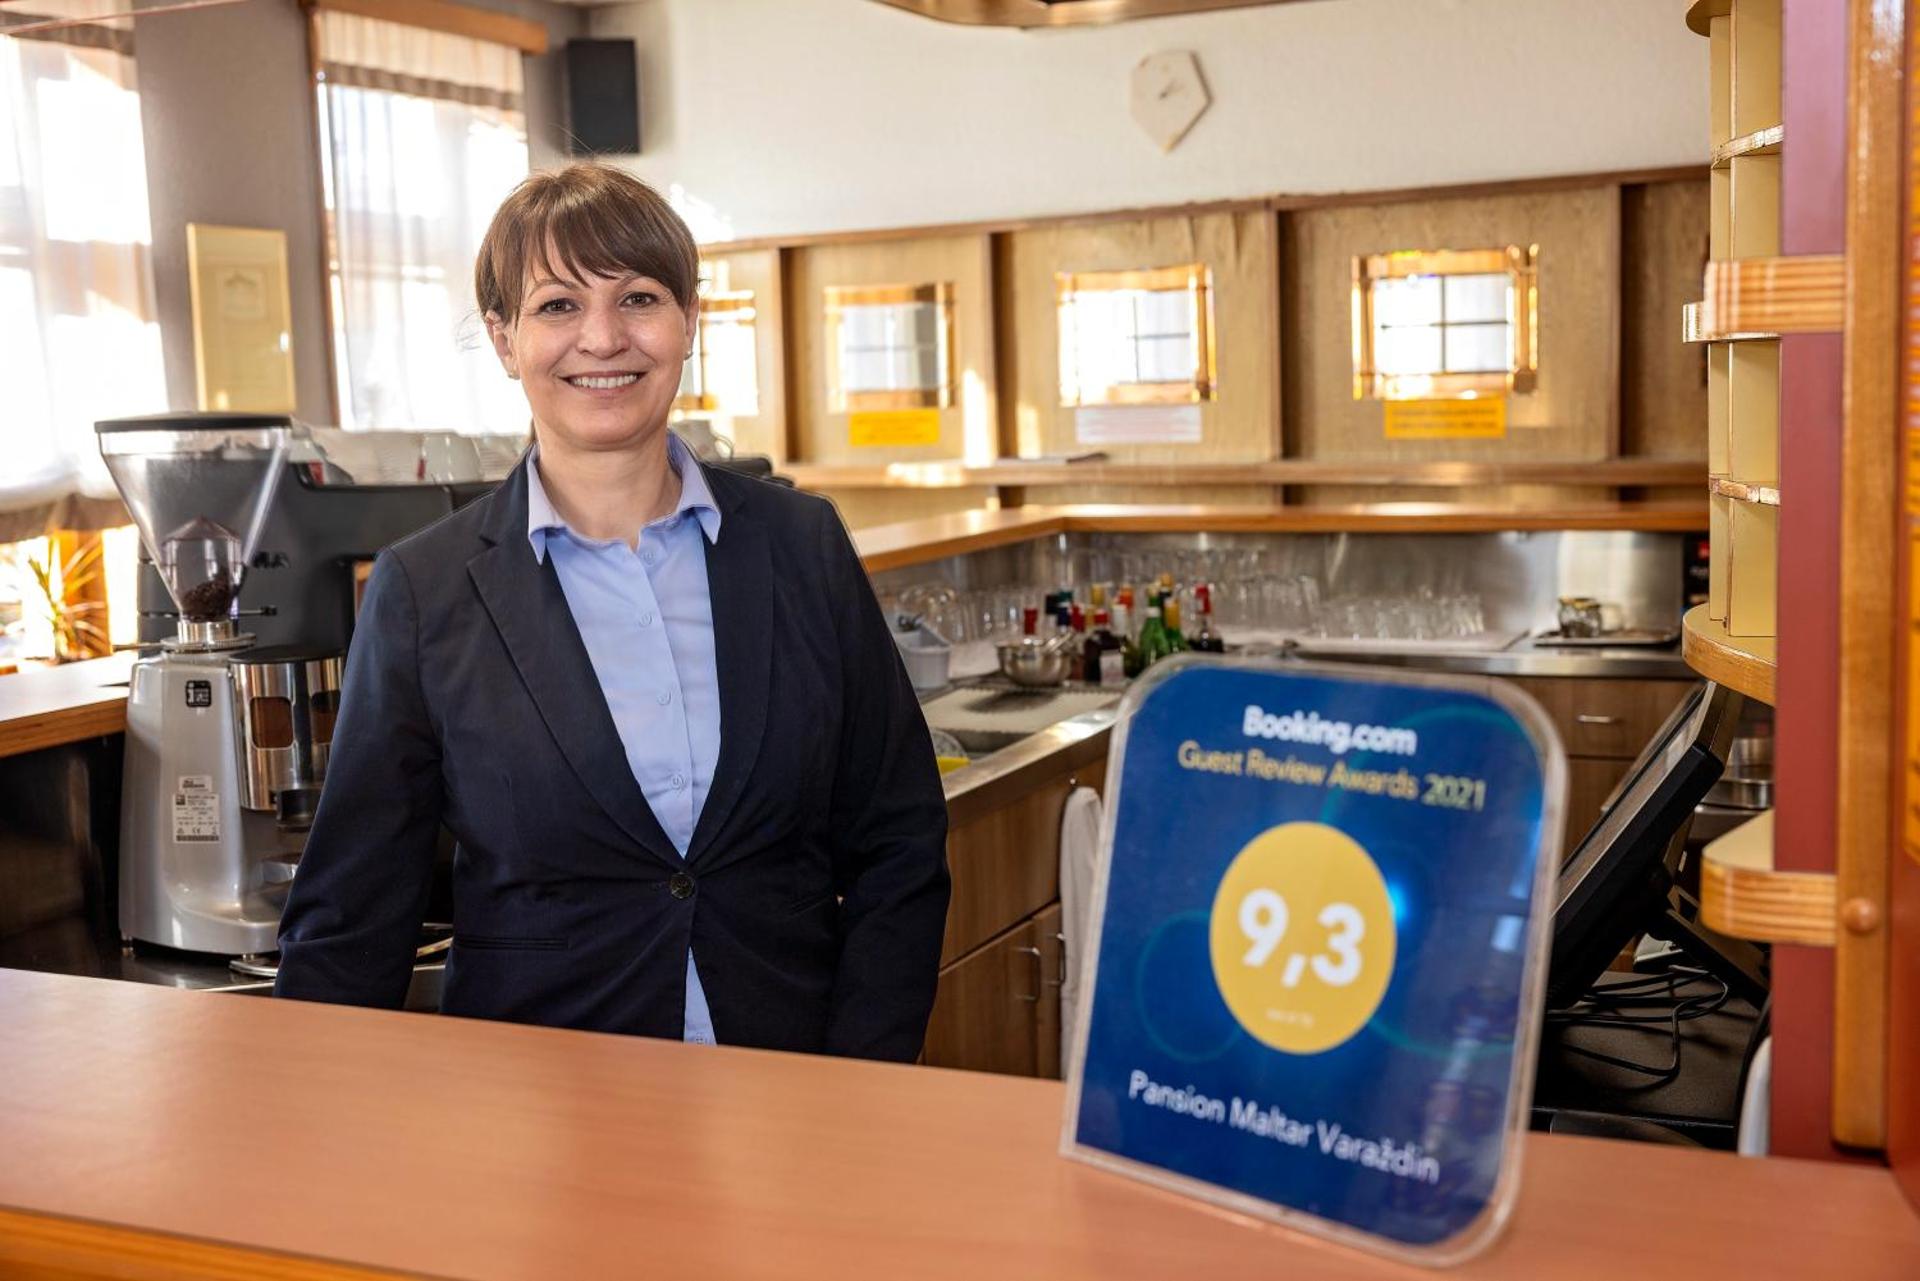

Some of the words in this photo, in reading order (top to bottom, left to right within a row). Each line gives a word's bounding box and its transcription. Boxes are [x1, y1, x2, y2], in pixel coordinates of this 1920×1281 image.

[1243, 705, 1417, 756] Booking.com
[1178, 740, 1242, 775] Guest
[1246, 748, 1326, 786] Review
[1327, 762, 1418, 800] Awards
[1422, 773, 1486, 811] 2021
[1238, 888, 1366, 988] 9,3
[1129, 1070, 1225, 1122] Pansion
[1229, 1097, 1314, 1147] Maltar
[1316, 1119, 1440, 1184] Varaždin
